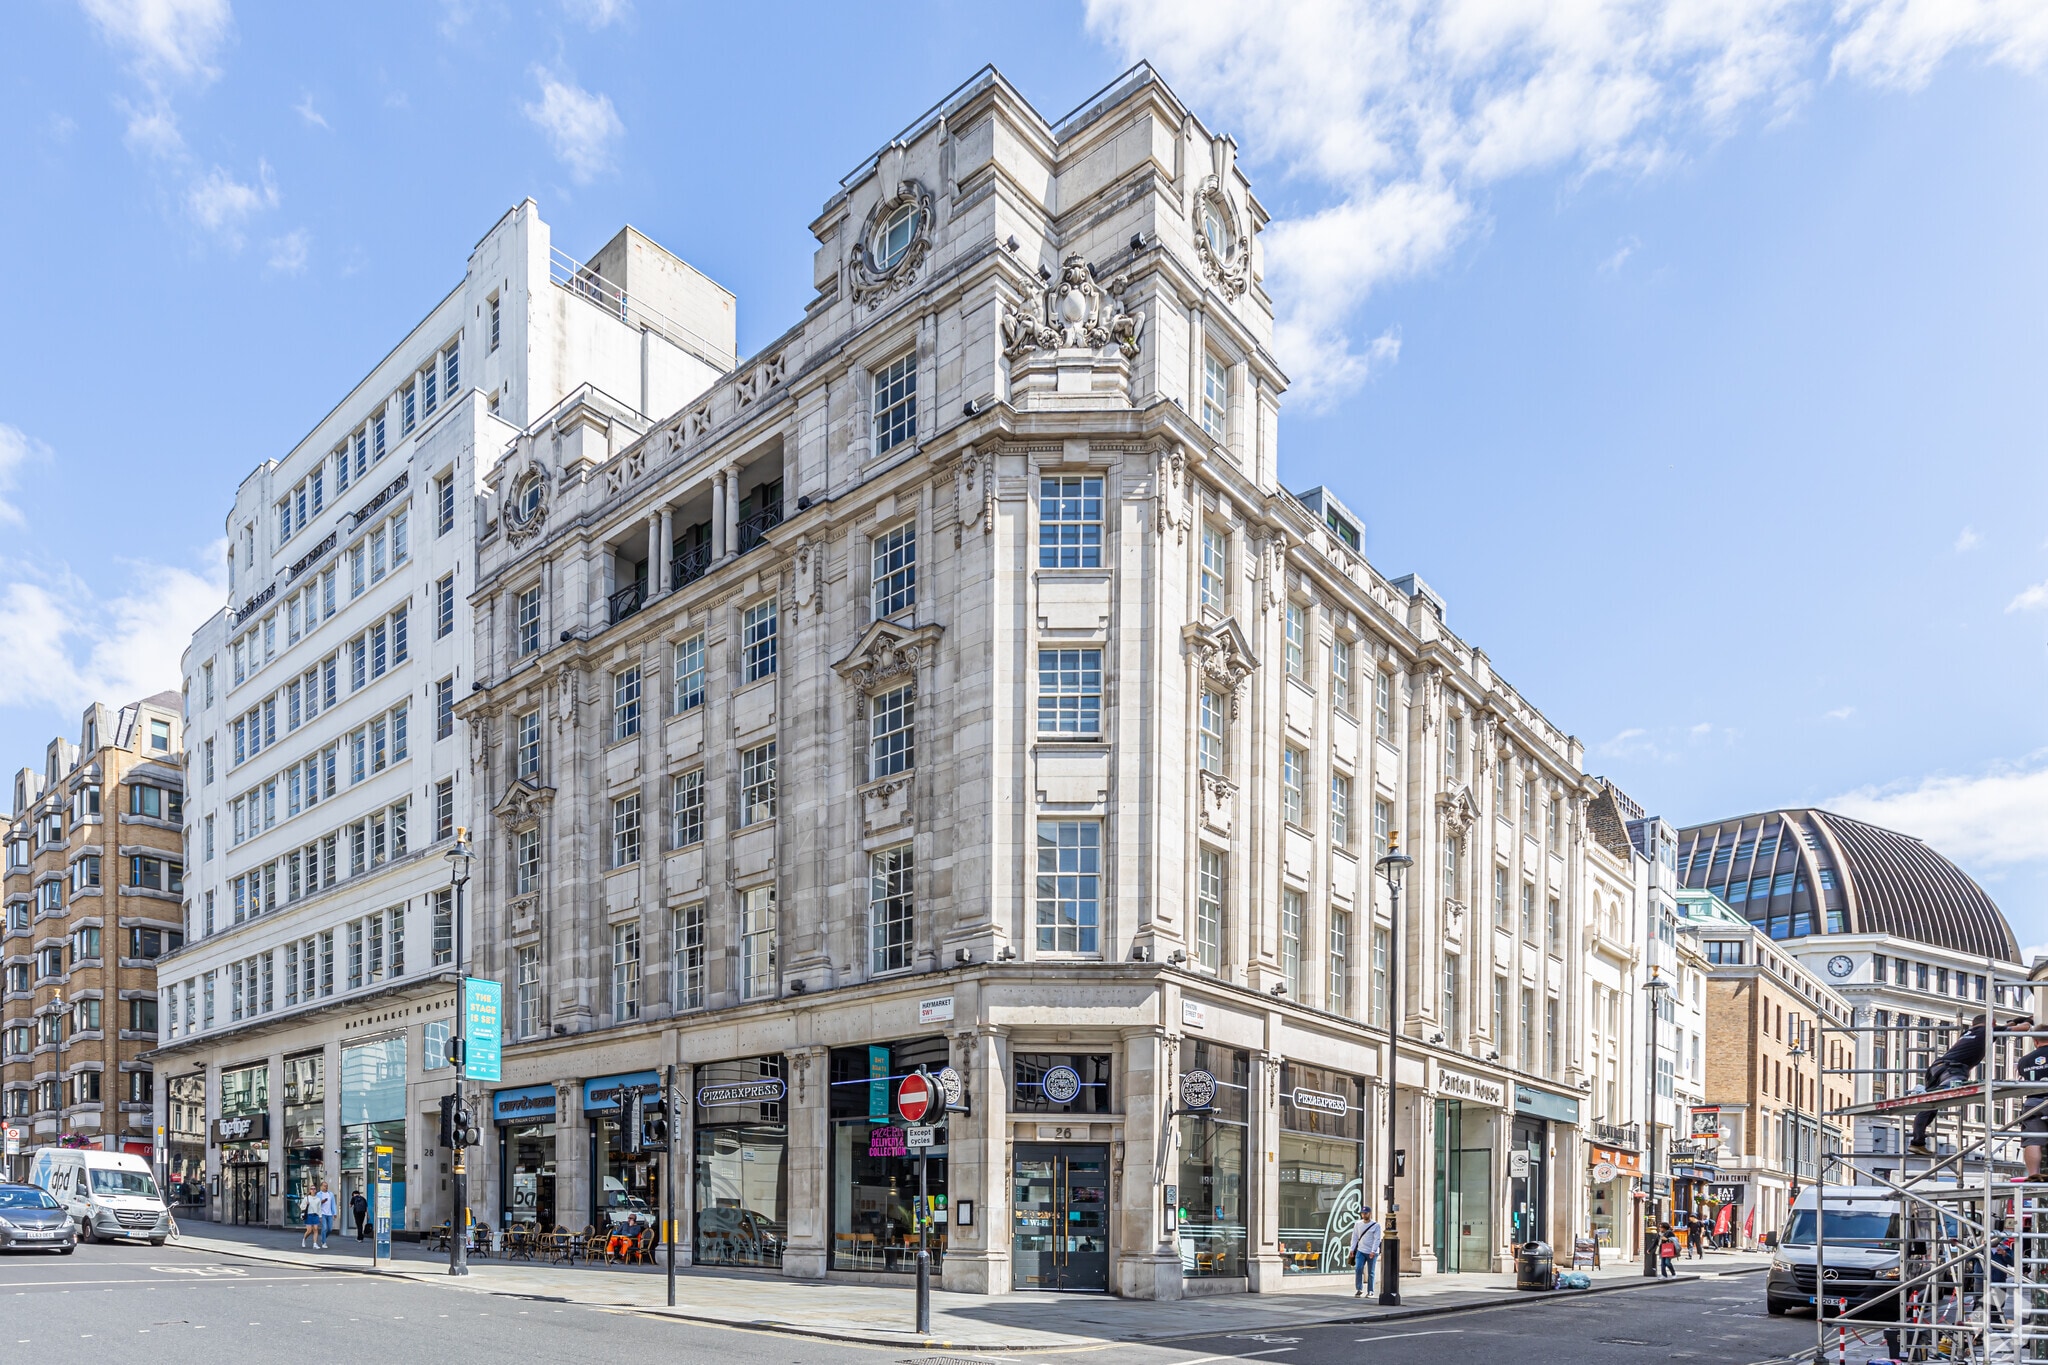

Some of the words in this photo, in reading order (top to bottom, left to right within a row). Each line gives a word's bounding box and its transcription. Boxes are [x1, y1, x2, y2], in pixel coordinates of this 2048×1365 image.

[475, 993, 492, 1003] THE
[470, 1003, 497, 1015] STAGE
[922, 999, 951, 1009] HAYMARKET
[345, 1009, 410, 1029] HAYMARKET
[417, 998, 455, 1014] HOUSE
[470, 1014, 479, 1023] IS
[481, 1015, 496, 1025] SET
[1439, 1069, 1471, 1096] Panton
[1474, 1078, 1500, 1103] House
[703, 1084, 778, 1102] PIZZAEXPRESS
[1298, 1093, 1345, 1110] PIZZAEXPRESS
[909, 1129, 931, 1137] Except
[1055, 1127, 1072, 1139] 26
[910, 1136, 930, 1144] cycles
[424, 1148, 434, 1157] 28
[869, 1147, 907, 1157] COLLECTION
[51, 1164, 72, 1195] dpd
[1717, 1187, 1735, 1195] EAT
